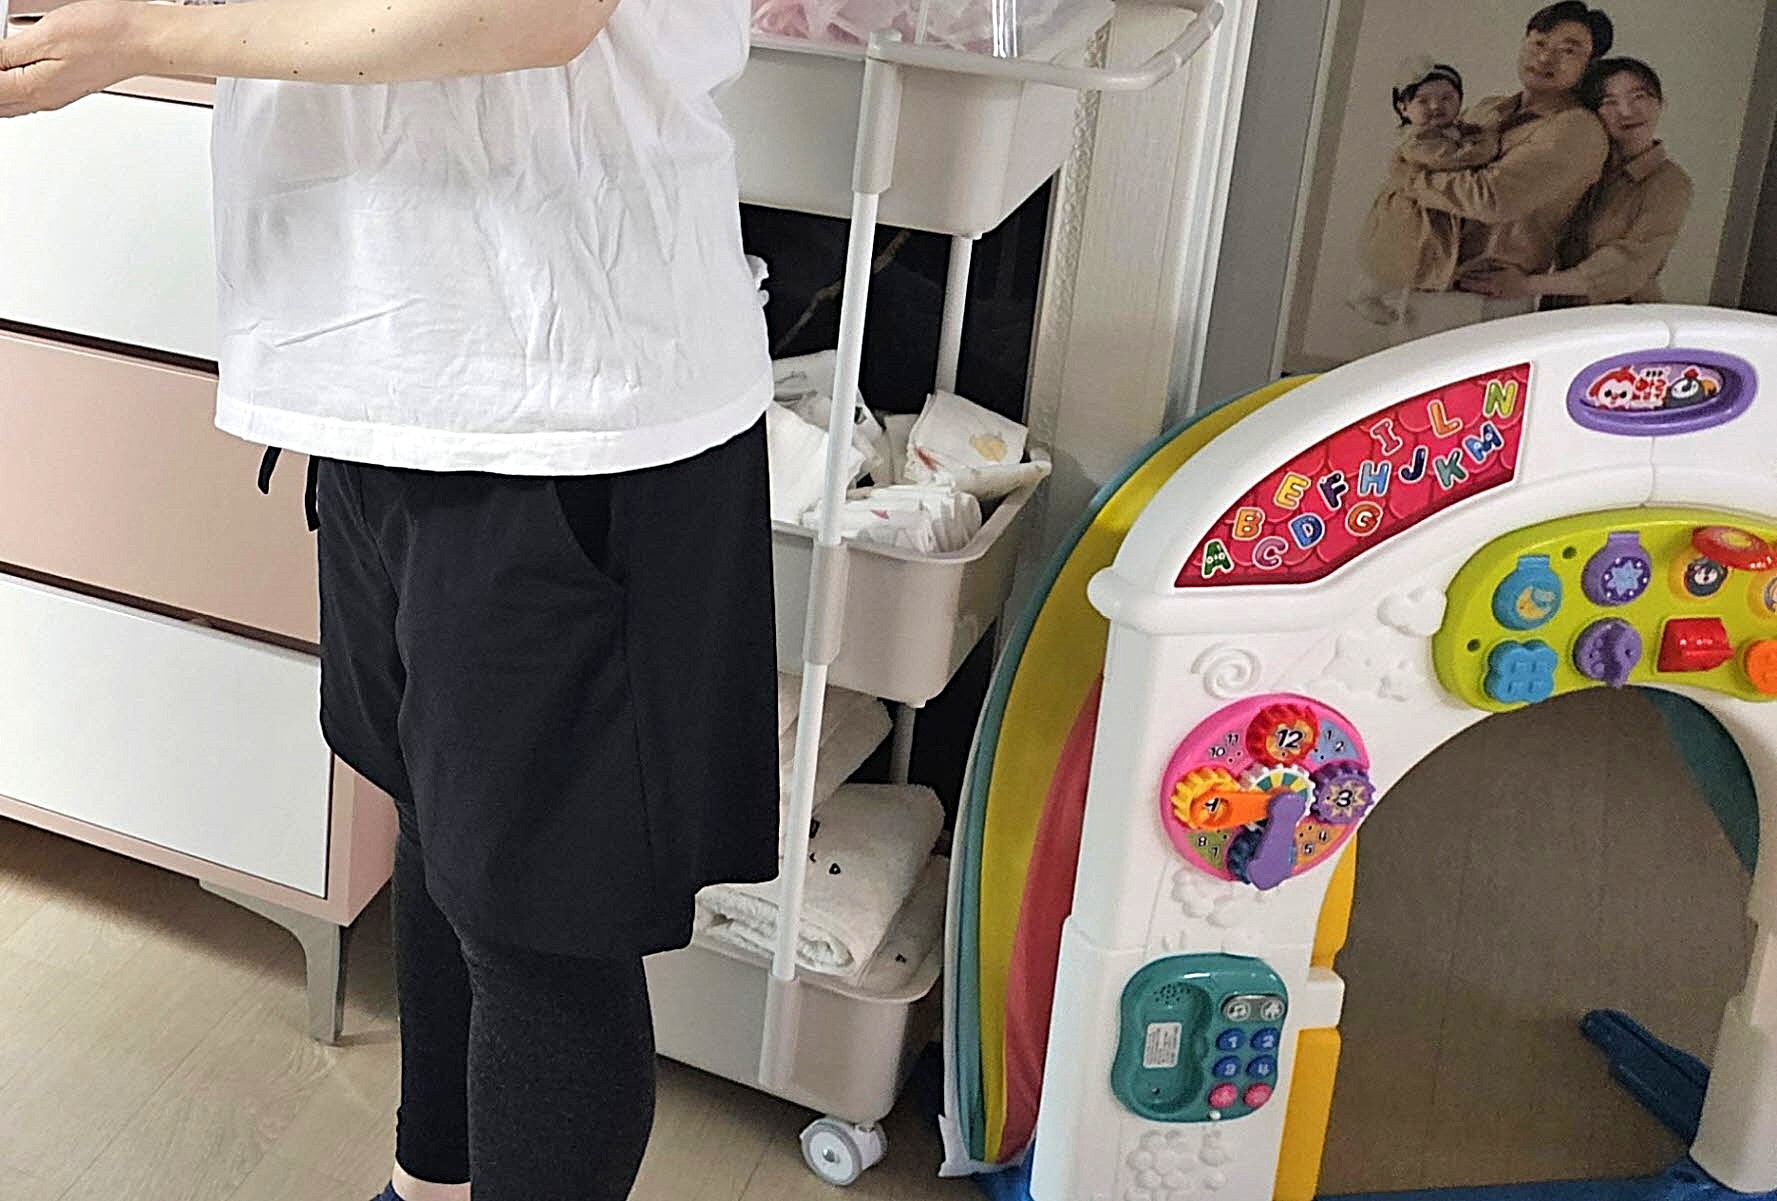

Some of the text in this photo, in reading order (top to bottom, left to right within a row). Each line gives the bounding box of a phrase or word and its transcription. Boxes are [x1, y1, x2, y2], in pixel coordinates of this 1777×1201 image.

[1204, 381, 1516, 576] A B C D E F G H I J K L M N
[1227, 734, 1239, 744] 11
[1278, 729, 1303, 748] 12
[1210, 746, 1226, 757] 10
[1335, 741, 1345, 752] 2
[1336, 790, 1352, 807] 3
[1197, 836, 1207, 847] 8
[1228, 1035, 1274, 1048] 1 2
